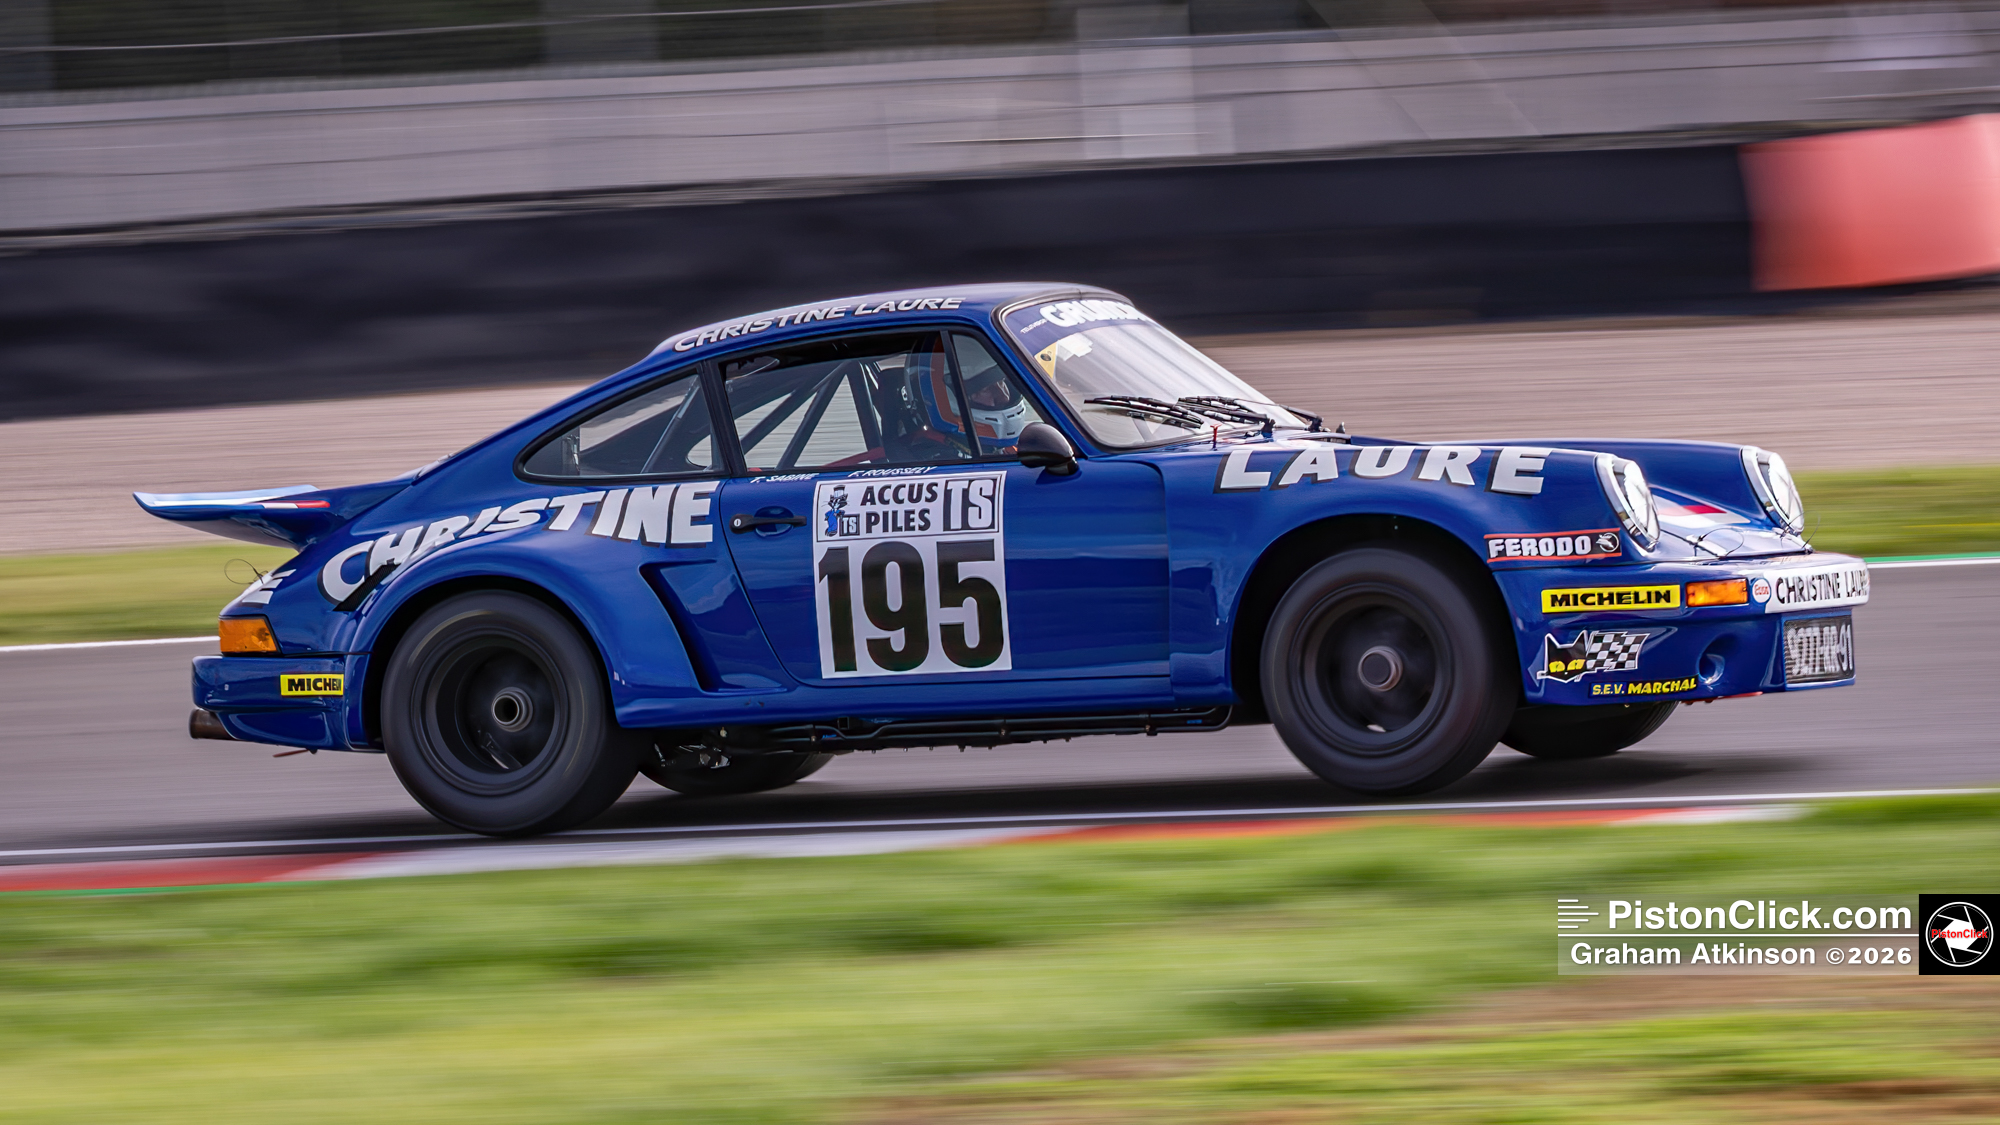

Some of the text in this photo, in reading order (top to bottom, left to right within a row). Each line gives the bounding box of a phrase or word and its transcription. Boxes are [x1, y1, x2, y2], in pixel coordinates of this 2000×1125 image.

[674, 297, 966, 352] CHRISTINE LAURE
[1217, 446, 1553, 495] LAURE
[860, 481, 939, 506] ACCUS
[946, 478, 994, 530] TS
[842, 516, 857, 534] TS
[865, 508, 932, 534] PILES
[320, 480, 720, 602] CHRISTINE
[1488, 535, 1593, 558] FERODO
[1550, 589, 1672, 607] MICHELIN
[1776, 572, 1841, 604] CHRISTINE
[818, 538, 1005, 672] 195
[1592, 677, 1697, 696] S.E.V. MARCHAL
